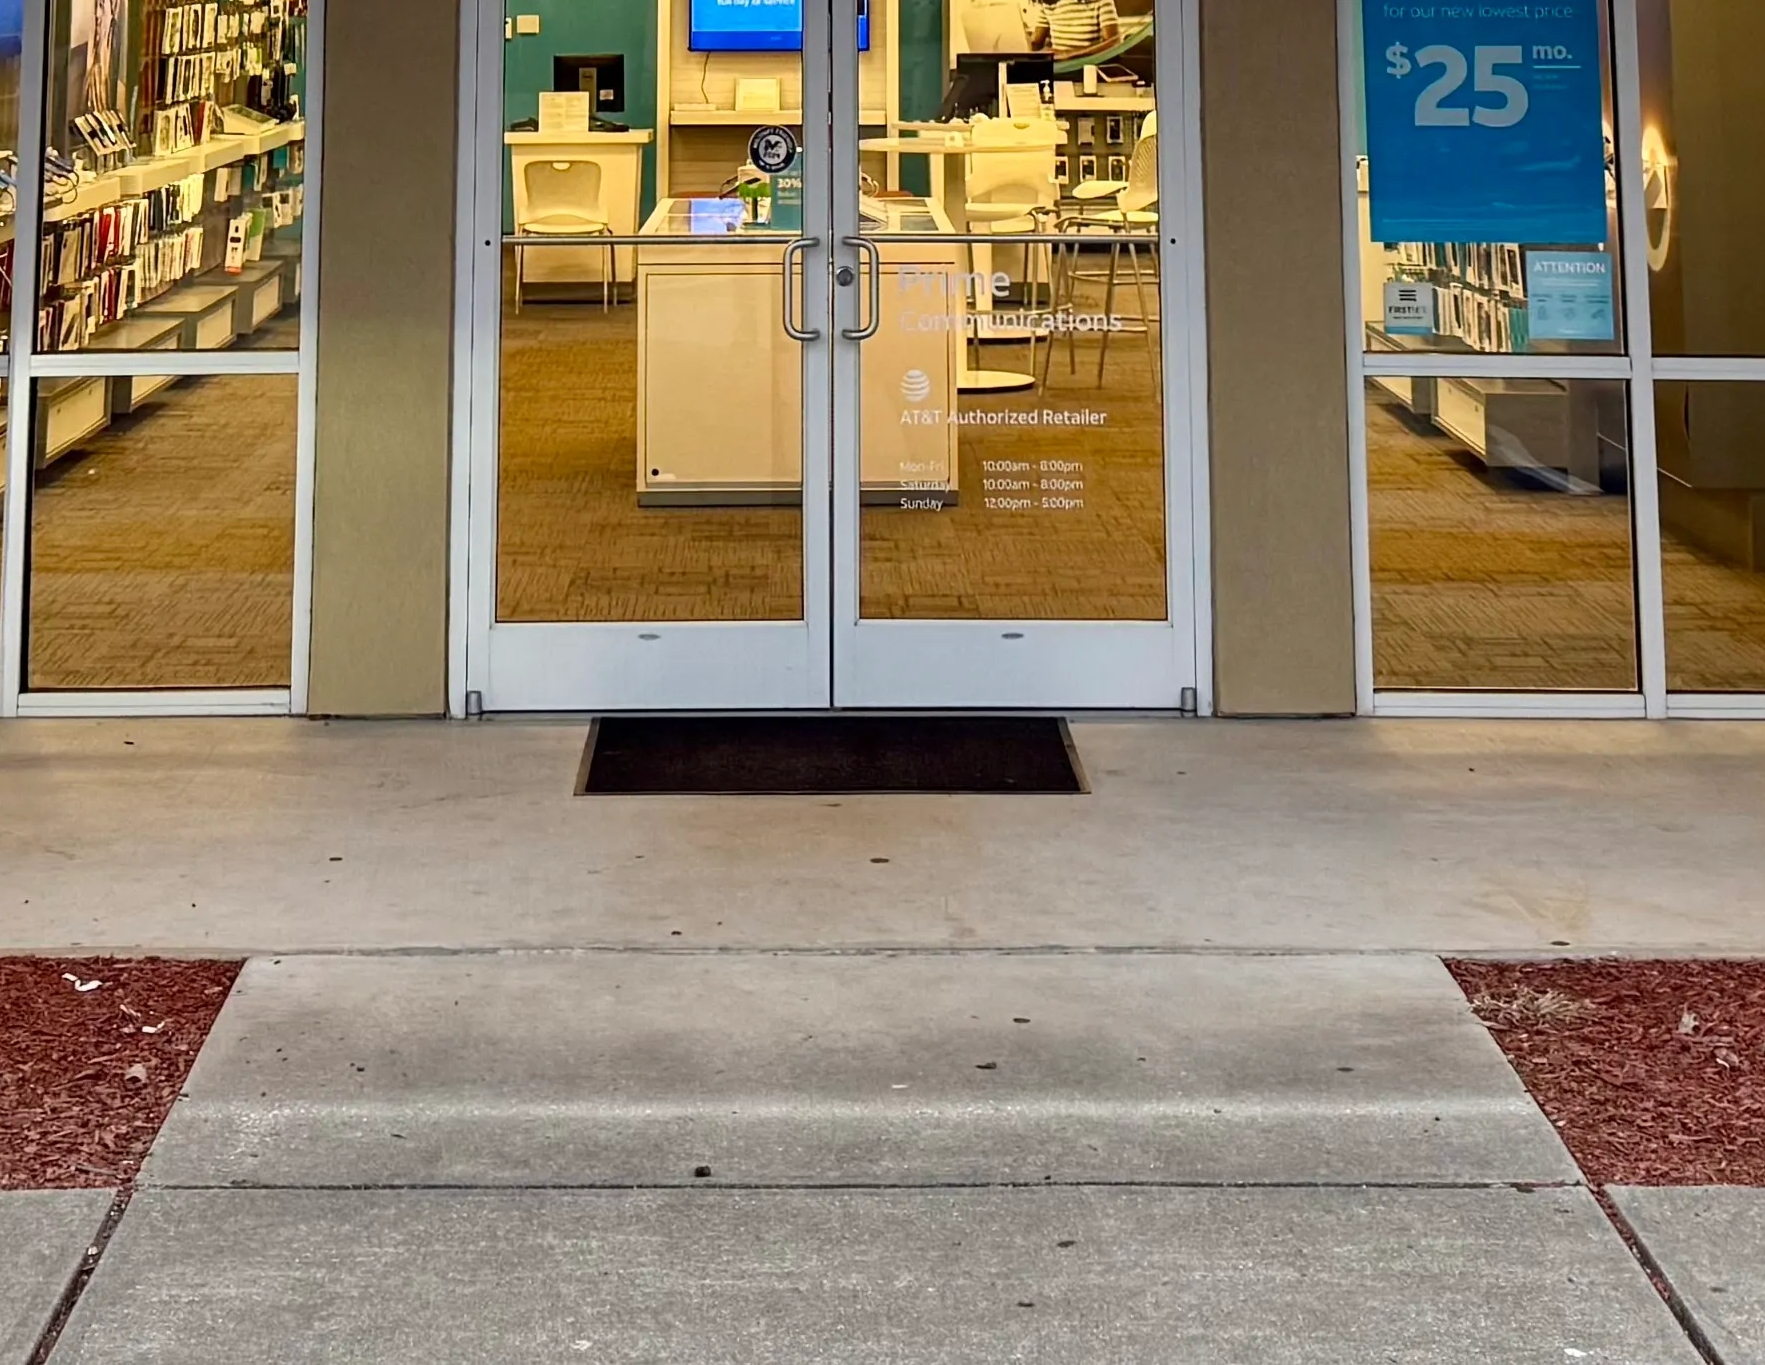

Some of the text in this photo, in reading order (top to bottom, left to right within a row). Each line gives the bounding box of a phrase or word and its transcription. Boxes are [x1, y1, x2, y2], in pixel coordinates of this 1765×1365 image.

[1383, 3, 1406, 18] for
[1410, 6, 1436, 18] our
[1440, 6, 1474, 18] new
[1478, 4, 1531, 18] lowest
[1385, 41, 1573, 128] $25 mo.
[1534, 261, 1607, 275] ATTENTION
[897, 266, 1012, 298] Prime
[898, 307, 1123, 332] Communications
[900, 409, 1108, 425] AT&T Authorized Retailer
[899, 479, 951, 493] Saturday
[899, 497, 945, 512] Sunday
